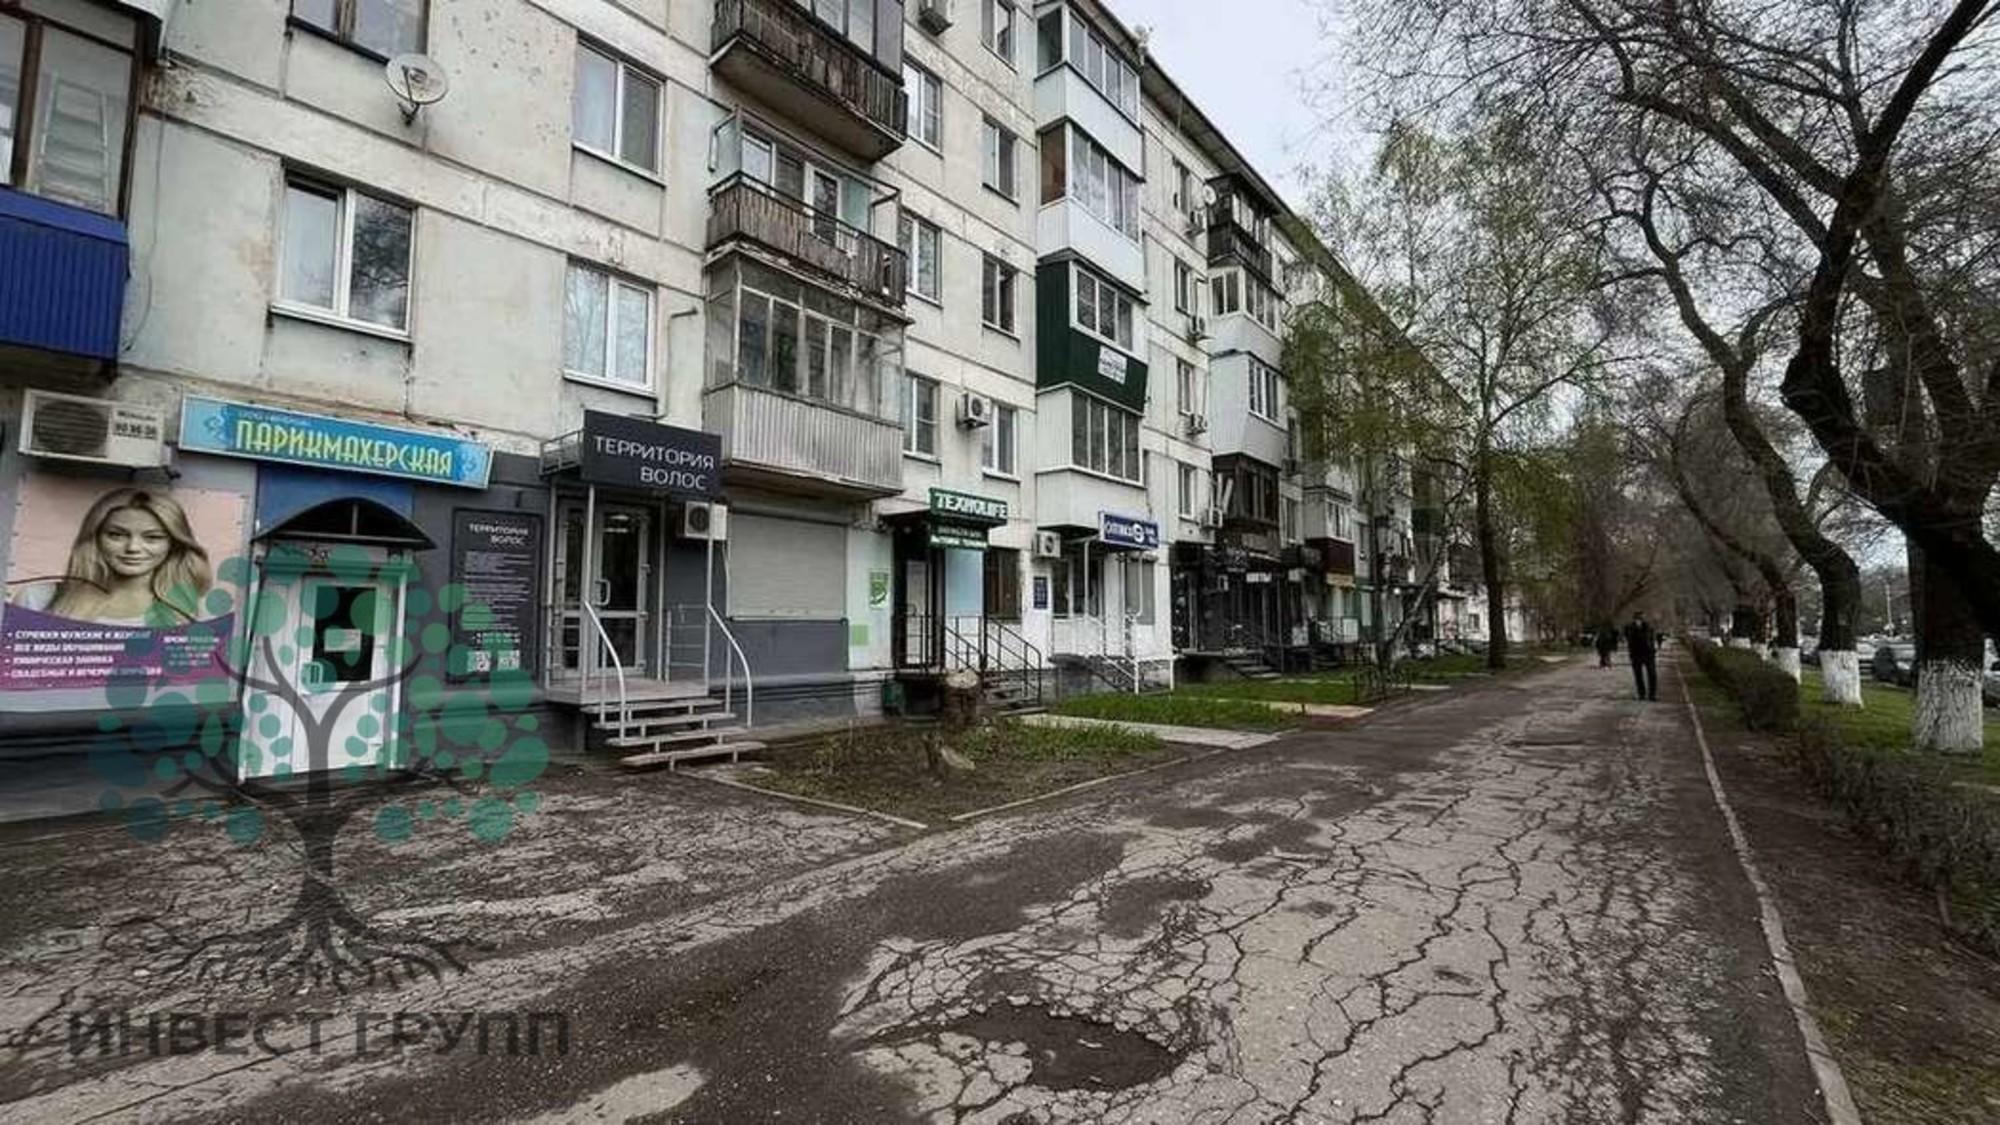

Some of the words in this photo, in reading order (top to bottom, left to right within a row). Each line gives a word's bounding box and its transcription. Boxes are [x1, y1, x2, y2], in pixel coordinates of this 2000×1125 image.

[235, 419, 453, 475] ПАРИКМАХЕРСКАЯ
[593, 435, 715, 470] ТЕРРИТОРИЯ
[640, 465, 707, 491] ВОЛОС
